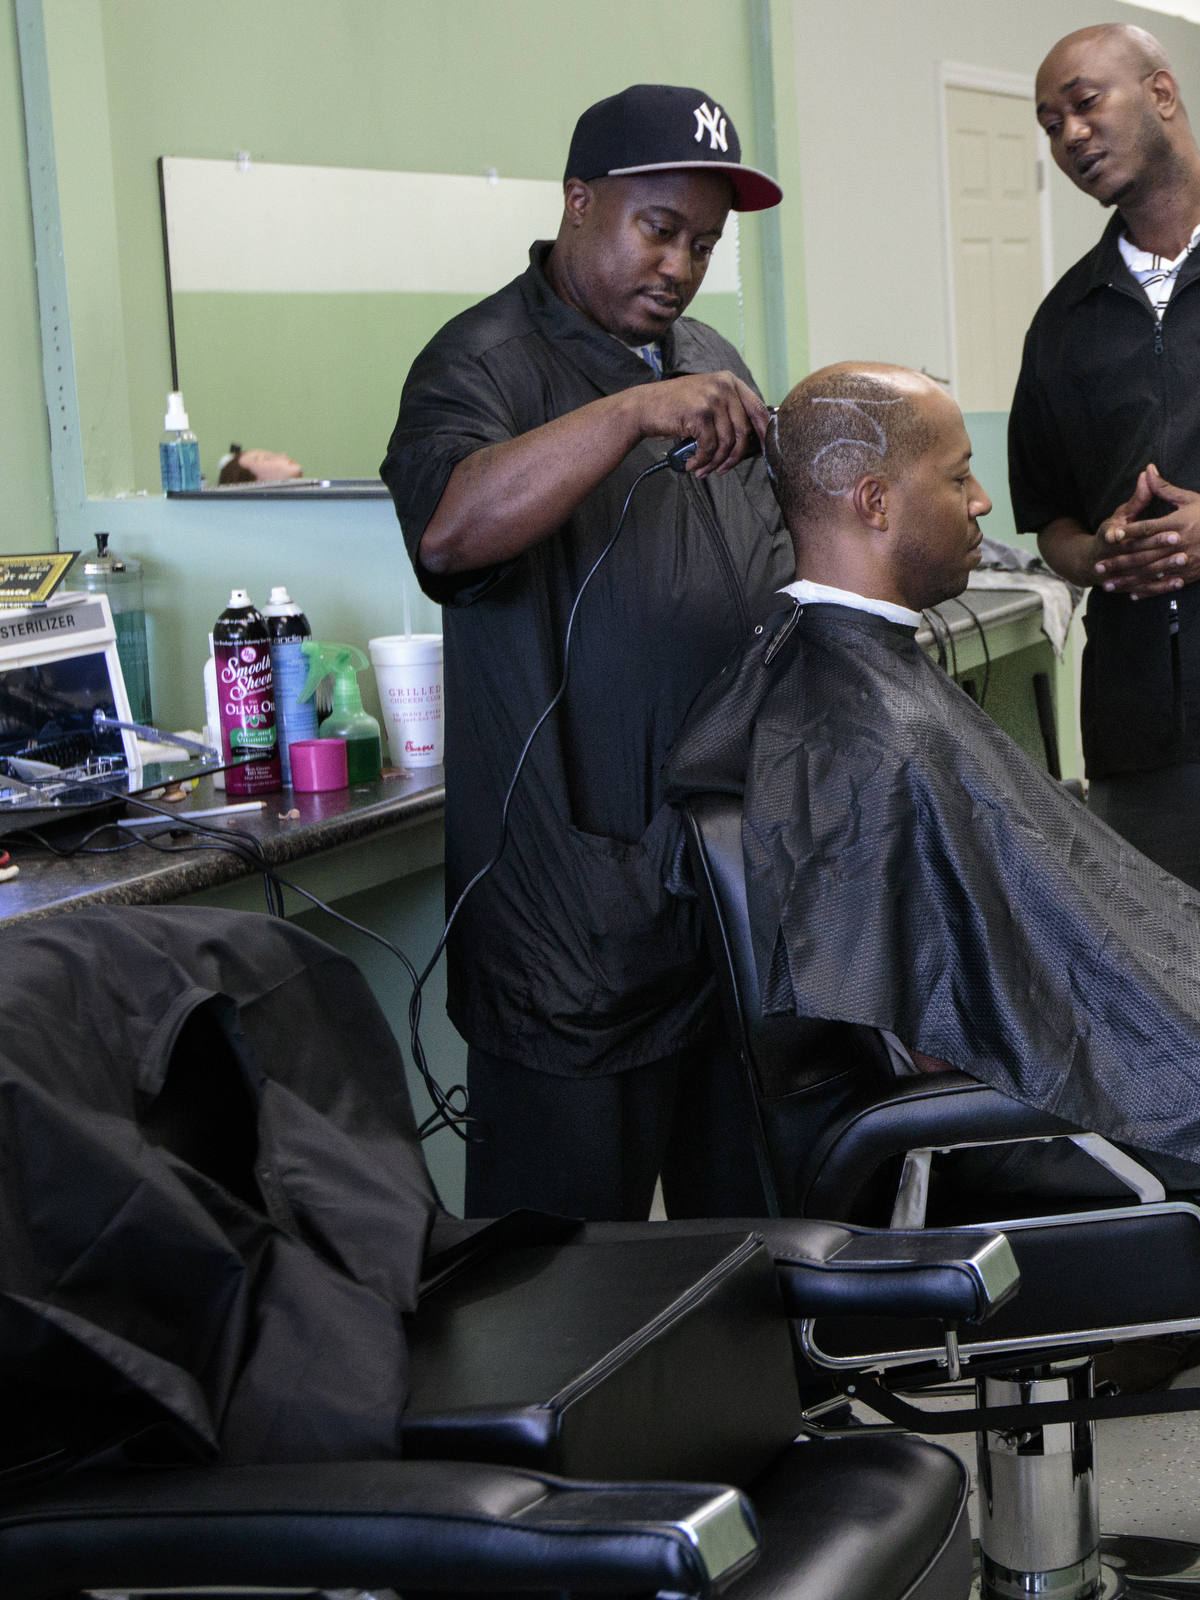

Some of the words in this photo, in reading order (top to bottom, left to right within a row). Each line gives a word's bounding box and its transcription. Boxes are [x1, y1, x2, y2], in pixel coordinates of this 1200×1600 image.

[693, 101, 728, 152] NY
[0, 614, 76, 640] STERILIZER
[221, 653, 271, 684] Smooth
[229, 672, 273, 702] Sheen
[388, 685, 442, 697] GRILLED
[225, 702, 260, 716] OLIVE
[390, 697, 424, 705] CHICKEN
[237, 735, 268, 743] Vitamin
